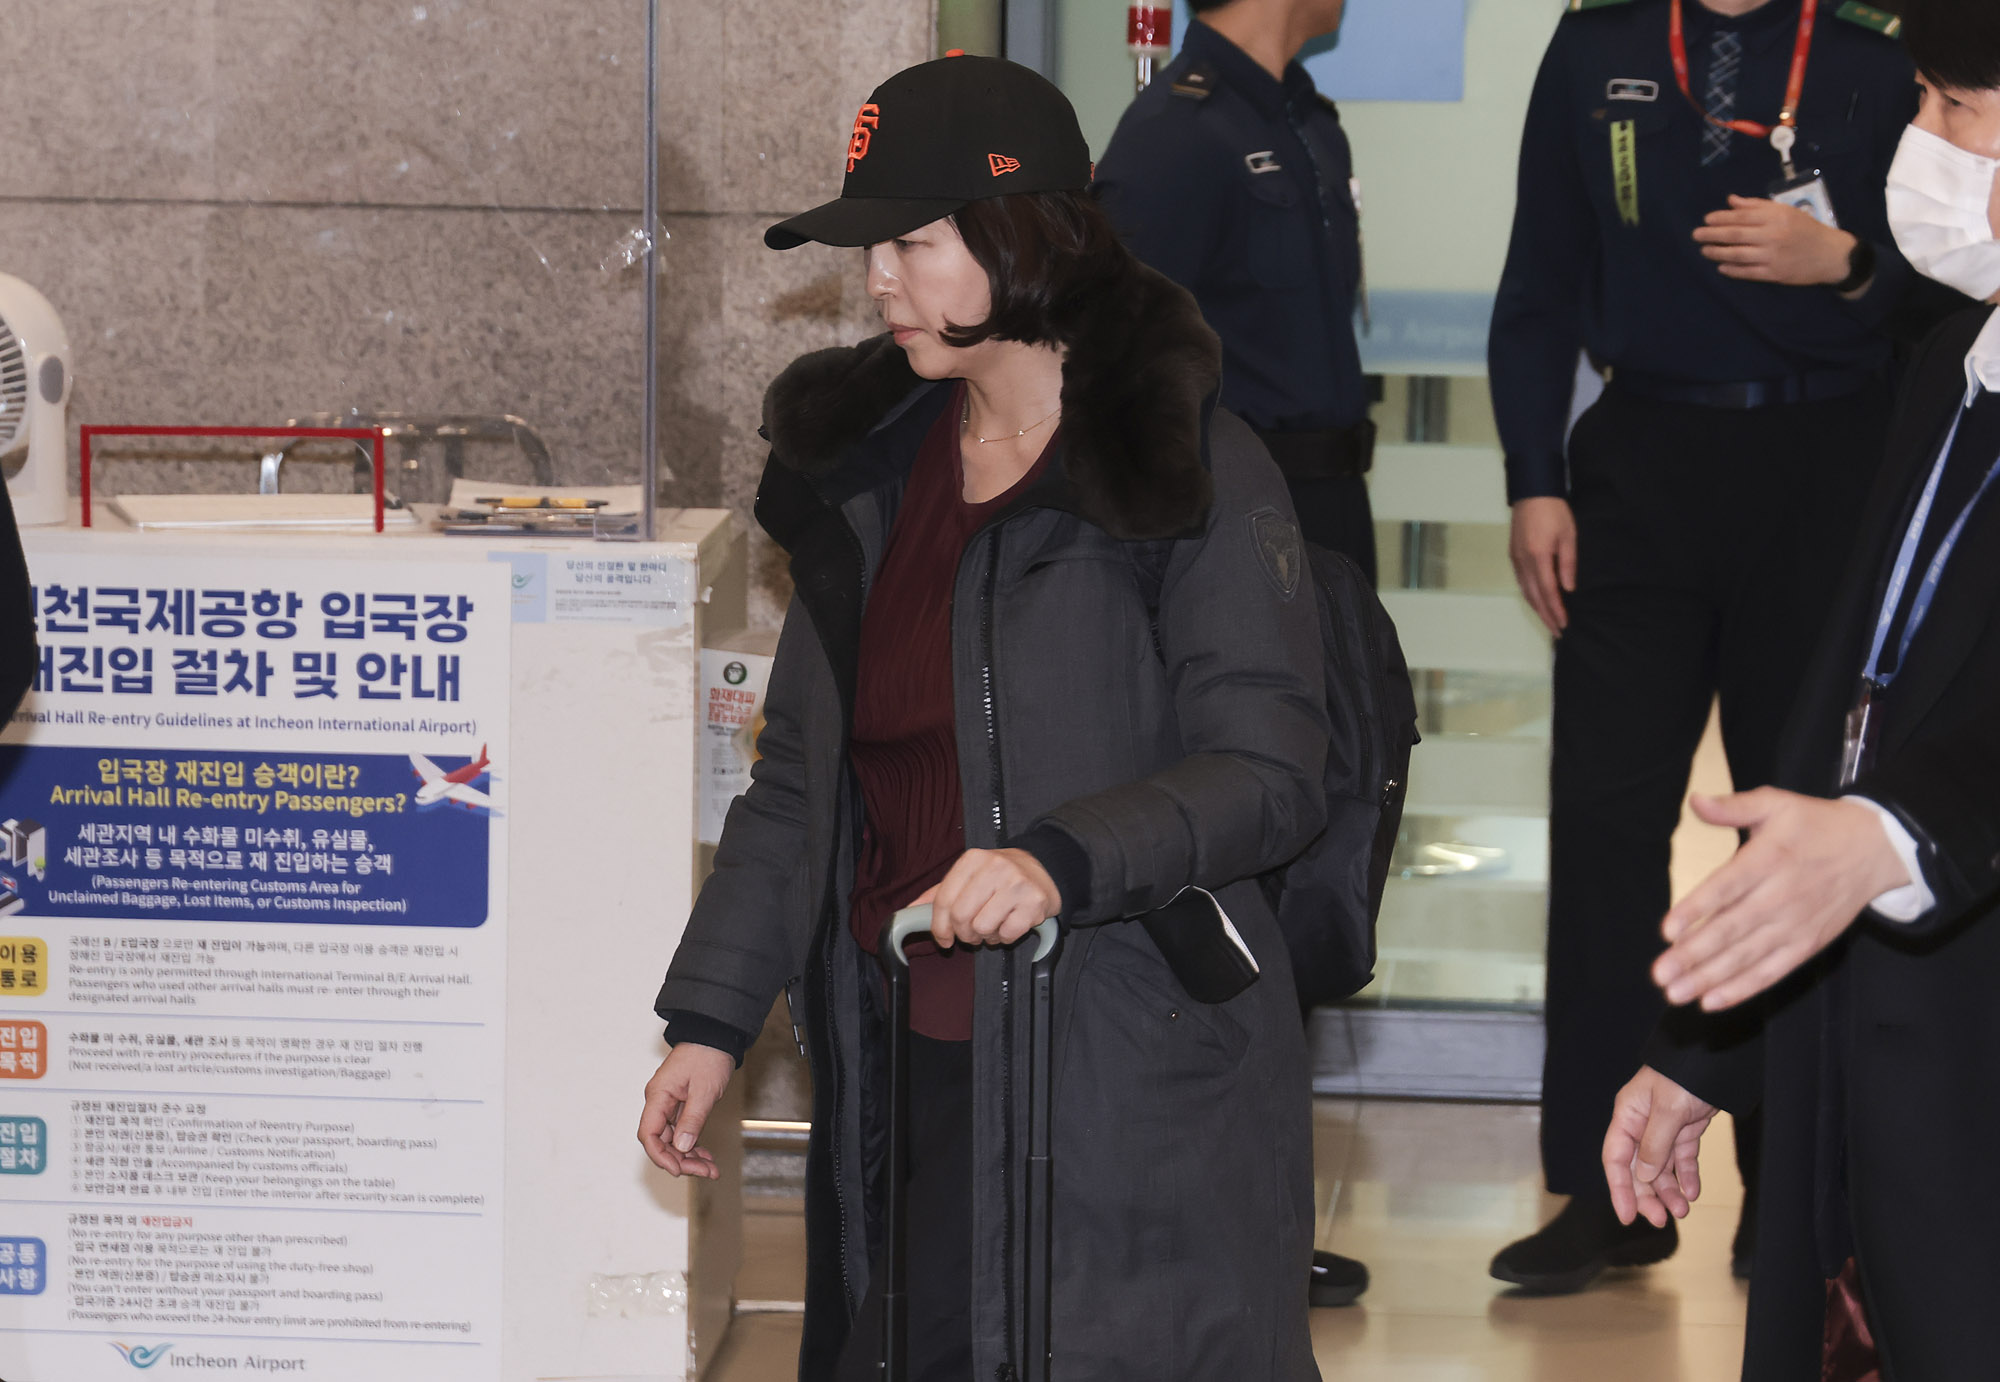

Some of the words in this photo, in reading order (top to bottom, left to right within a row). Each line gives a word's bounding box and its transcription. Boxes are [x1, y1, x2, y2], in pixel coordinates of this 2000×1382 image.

[320, 592, 474, 643] 입국장
[172, 648, 274, 697] 절차
[293, 652, 338, 700] 및
[356, 653, 460, 701] 안내
[55, 710, 83, 723] Hall
[88, 712, 150, 726] Re-entry
[155, 713, 232, 727] Guidelines
[236, 717, 250, 727] at
[255, 717, 313, 729] Incheon
[318, 718, 414, 732] International
[418, 720, 476, 734] Airport)
[98, 758, 167, 788] 입국장
[175, 760, 243, 787] 재진입
[253, 762, 359, 790] 승객이란?
[50, 785, 121, 805] Arrival
[128, 786, 170, 806] Hall
[176, 789, 269, 810] Re-entry
[275, 791, 406, 814] Passengers?
[78, 823, 151, 845] 세관지역
[158, 825, 176, 845] 내
[183, 825, 238, 847] 수화물
[245, 827, 306, 849] 미수취,
[312, 828, 373, 851] 유실물,
[64, 846, 138, 868] 세관조사
[145, 848, 162, 869] 등
[169, 849, 242, 869] 목적으로
[249, 851, 267, 871] 재
[274, 852, 348, 873] 진입하는
[355, 853, 391, 874] 승객
[92, 876, 169, 890] (Passengers
[171, 877, 248, 892] Re-entering
[250, 880, 307, 893] Customs
[308, 881, 338, 894] Area
[341, 880, 361, 894] for
[48, 890, 120, 904] Unclaimed
[121, 889, 180, 908] Baggage,
[184, 894, 211, 906] Lost
[214, 891, 254, 908] Items,
[256, 897, 272, 908] or
[274, 896, 330, 910] Customs
[333, 898, 406, 912] Inspection)
[170, 1355, 237, 1368] Incheon
[244, 1357, 304, 1370] Airport
